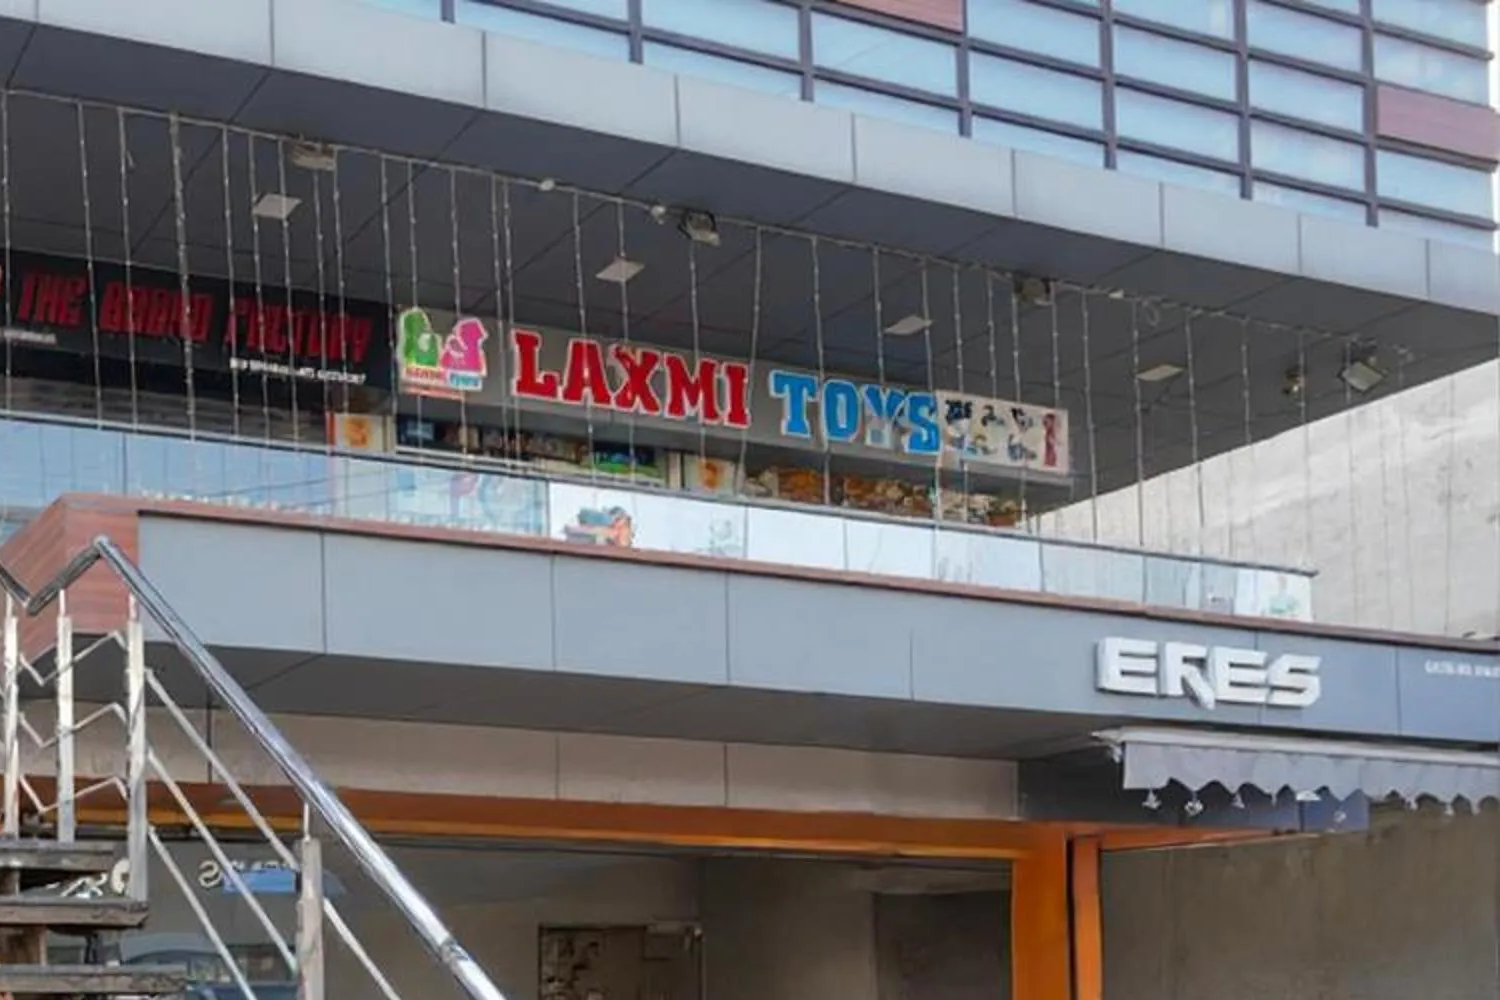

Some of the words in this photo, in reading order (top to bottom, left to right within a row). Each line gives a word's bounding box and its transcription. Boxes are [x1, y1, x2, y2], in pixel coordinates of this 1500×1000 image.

[18, 272, 88, 327] THE
[511, 328, 751, 428] LAXMI
[769, 368, 942, 456] TOYS
[1096, 635, 1323, 710] ERES
